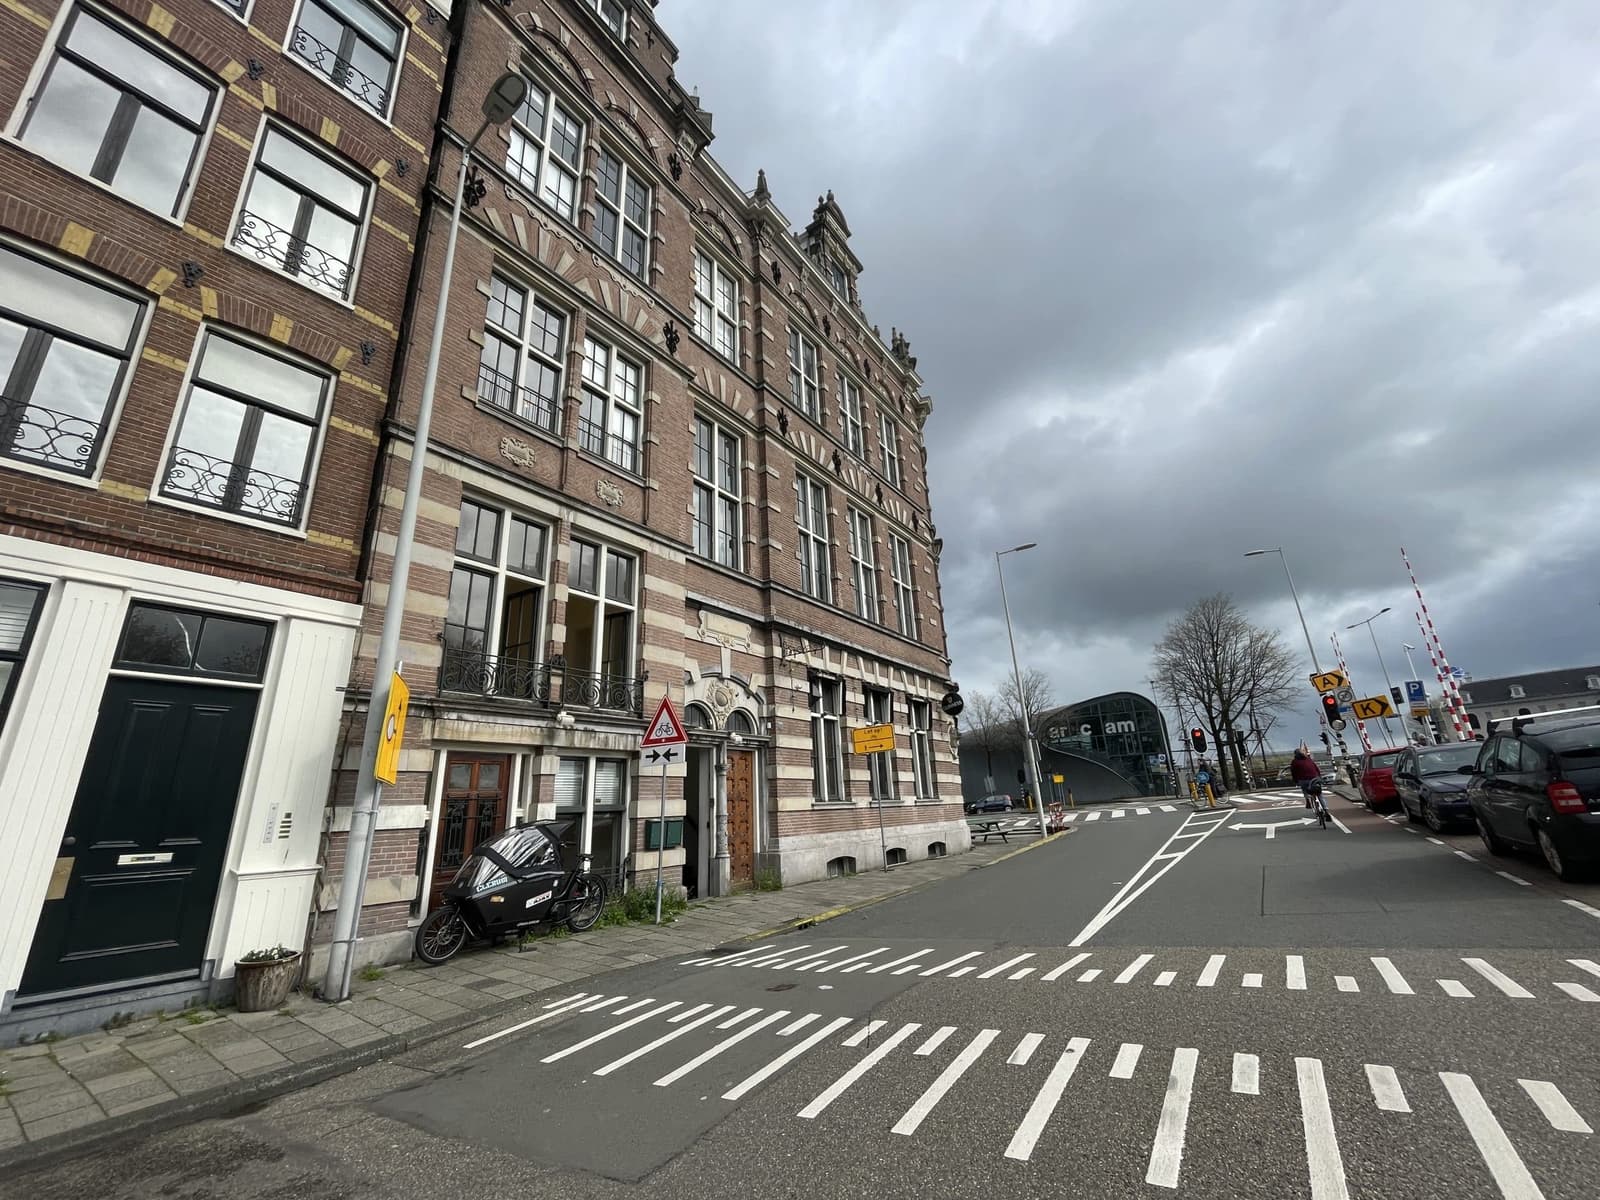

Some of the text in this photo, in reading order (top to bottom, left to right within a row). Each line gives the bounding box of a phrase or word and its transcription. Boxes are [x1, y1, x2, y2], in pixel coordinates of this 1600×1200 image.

[1322, 677, 1334, 688] A
[1410, 682, 1420, 694] P
[1360, 703, 1376, 715] K
